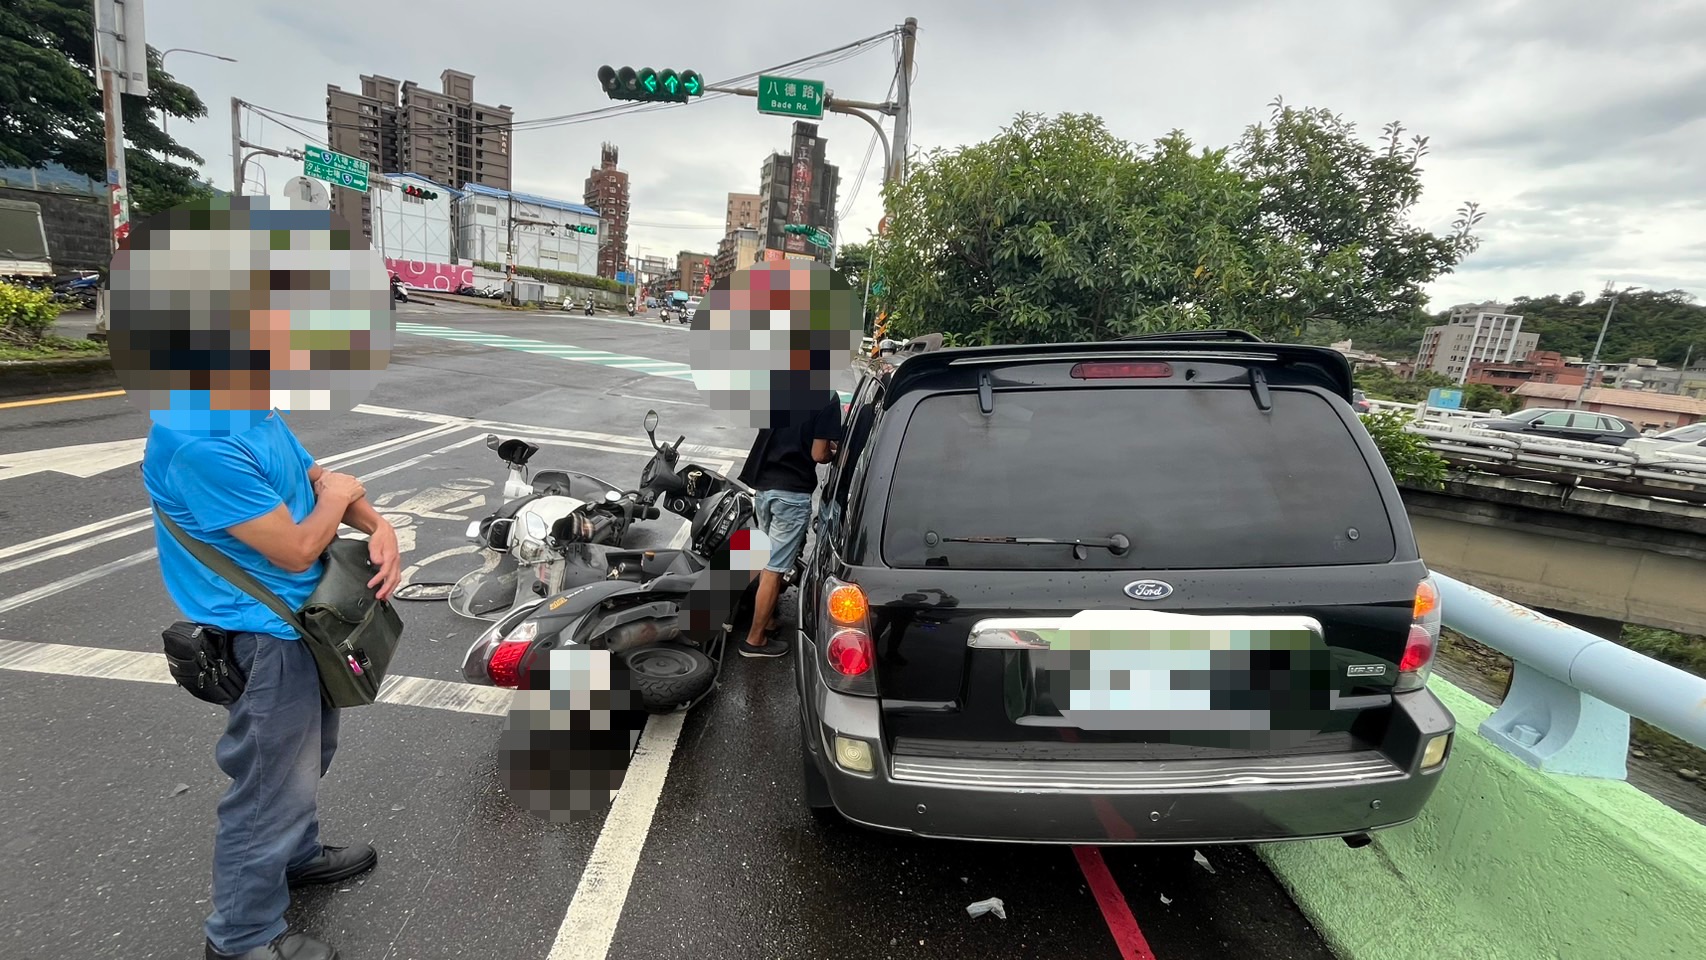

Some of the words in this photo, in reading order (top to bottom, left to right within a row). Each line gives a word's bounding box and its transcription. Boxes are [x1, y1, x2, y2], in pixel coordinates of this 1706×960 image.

[767, 81, 814, 99] 八德路
[771, 99, 792, 109] Bade
[796, 102, 809, 111] Rd.
[1135, 583, 1163, 596] Ford
